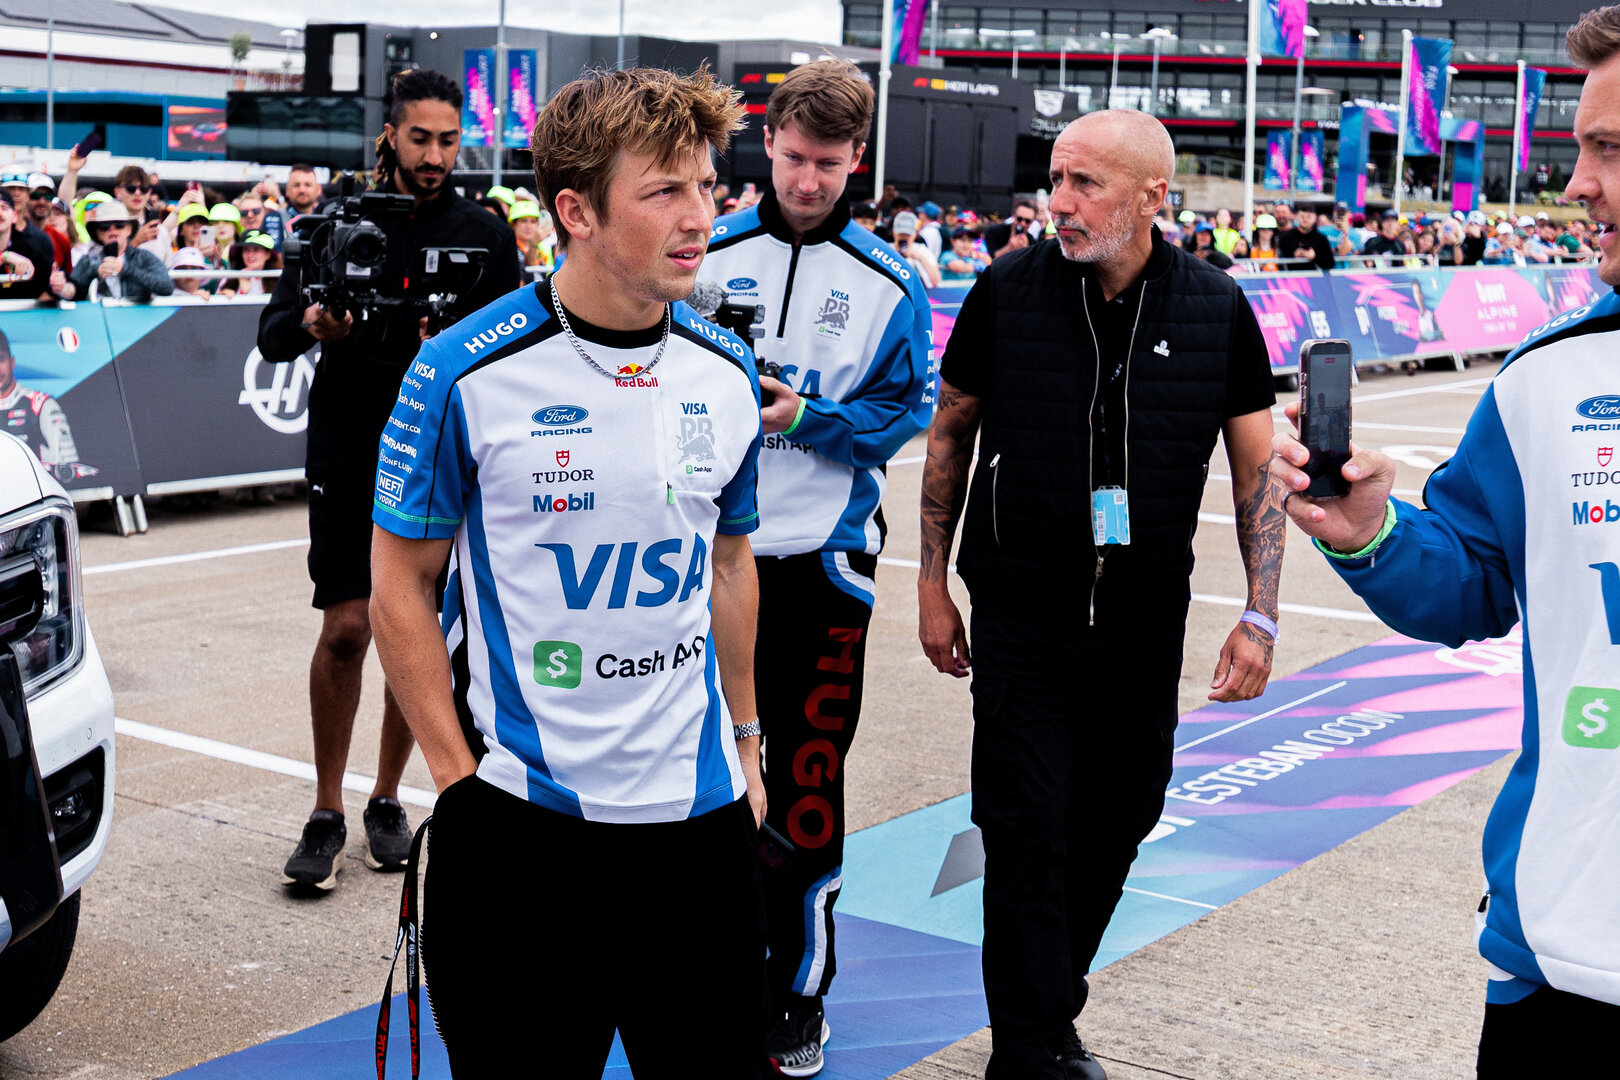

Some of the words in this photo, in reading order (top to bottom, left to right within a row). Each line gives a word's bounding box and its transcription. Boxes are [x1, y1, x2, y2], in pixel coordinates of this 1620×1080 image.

[945, 80, 968, 93] HOT
[969, 82, 999, 96] LAPS
[871, 247, 911, 280] HUGO
[731, 279, 751, 289] Ford
[830, 289, 849, 302] VISA
[1477, 304, 1518, 320] ALPINE
[463, 312, 528, 355] HUGO
[1310, 310, 1331, 338] 55
[689, 318, 745, 357] HUGO
[414, 360, 436, 381] VISA
[615, 377, 637, 388] Red
[636, 377, 659, 388] Bull
[408, 397, 425, 412] App
[679, 402, 708, 415] VISA
[543, 408, 577, 423] Ford
[530, 427, 593, 437] RACING
[380, 475, 402, 495] NEFT
[532, 469, 595, 484] TUDOR
[378, 493, 396, 509] VODKA
[533, 492, 595, 513] Mobil
[534, 532, 707, 610] VISA
[595, 651, 665, 680] Cash
[787, 627, 863, 849] HUGO
[1164, 740, 1335, 805] ESTEBAN
[1303, 707, 1404, 746] OCON
[376, 1034, 386, 1053] PIT
[781, 1042, 820, 1067] HUGO
